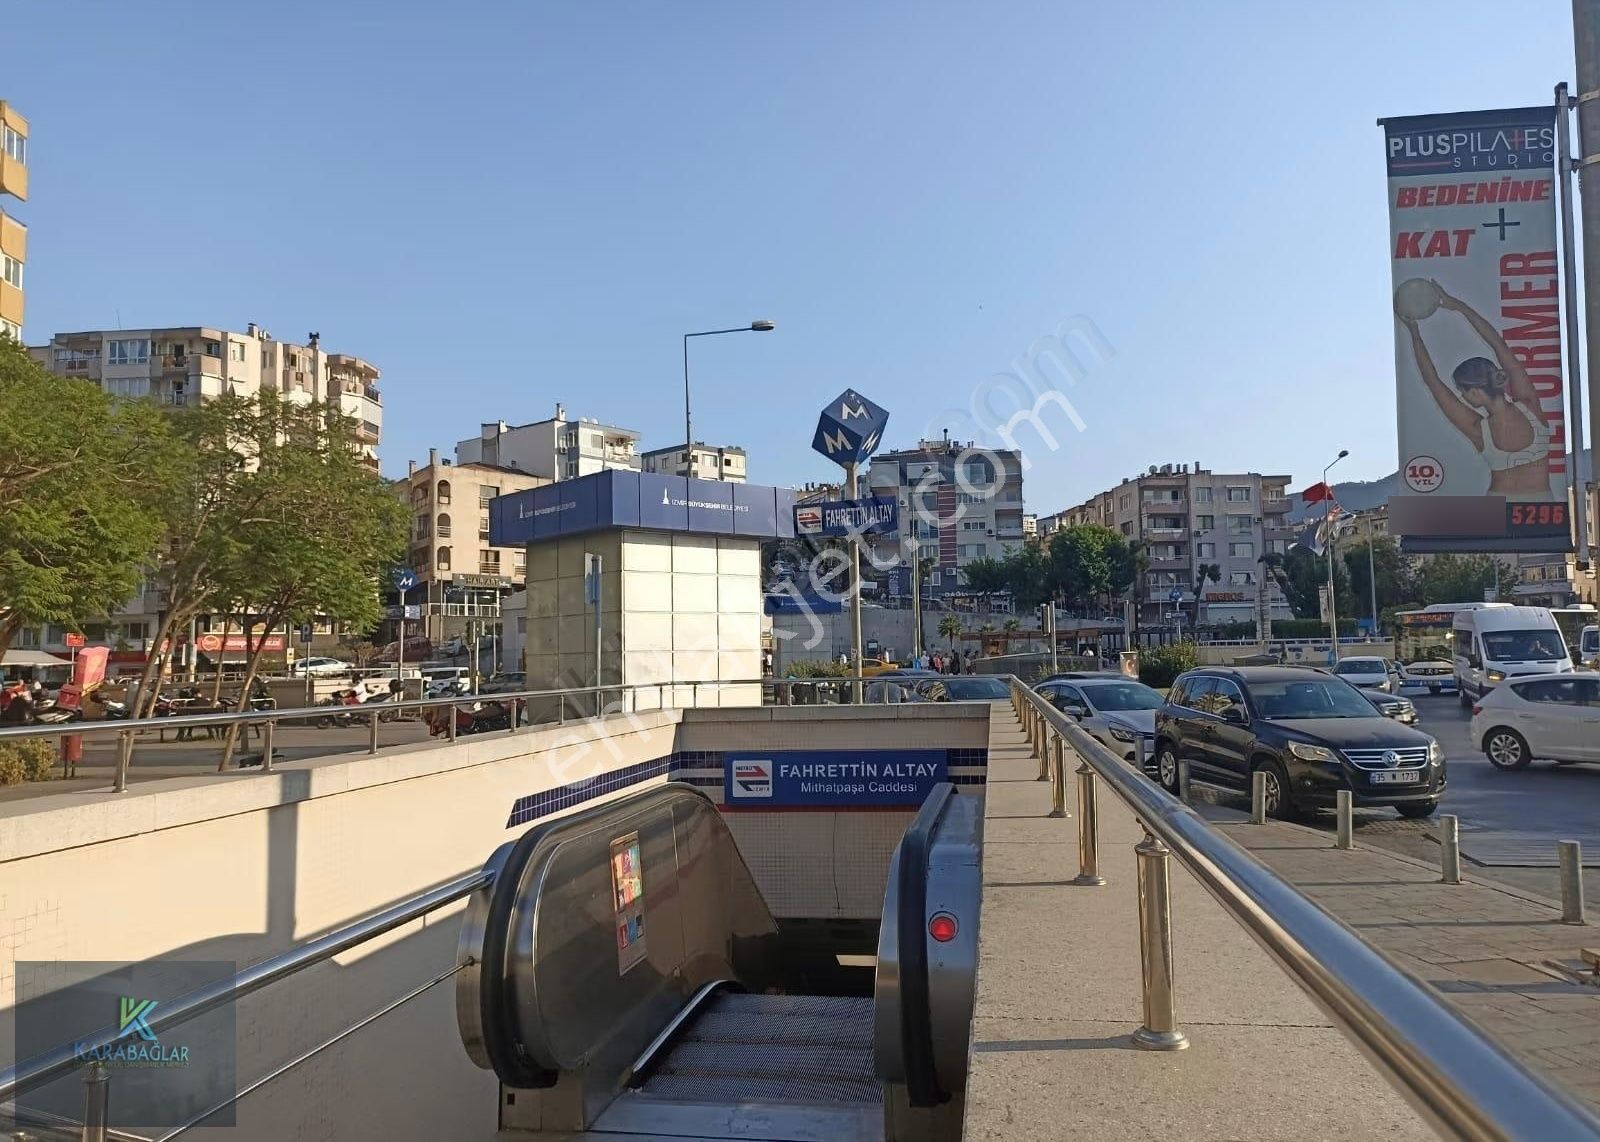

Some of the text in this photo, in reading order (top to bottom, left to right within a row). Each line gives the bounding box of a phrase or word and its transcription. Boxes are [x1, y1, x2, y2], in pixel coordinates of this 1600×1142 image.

[1453, 152, 1554, 168] STUDIO
[1396, 176, 1552, 208] BEDENİNE
[1395, 229, 1476, 259] KAT
[823, 428, 853, 454] M
[825, 504, 893, 528] FAHRETTİN ALTAY
[780, 761, 938, 778] FAHRETTİN ALTAY
[800, 781, 918, 796] Mithatpaşa Caddesi
